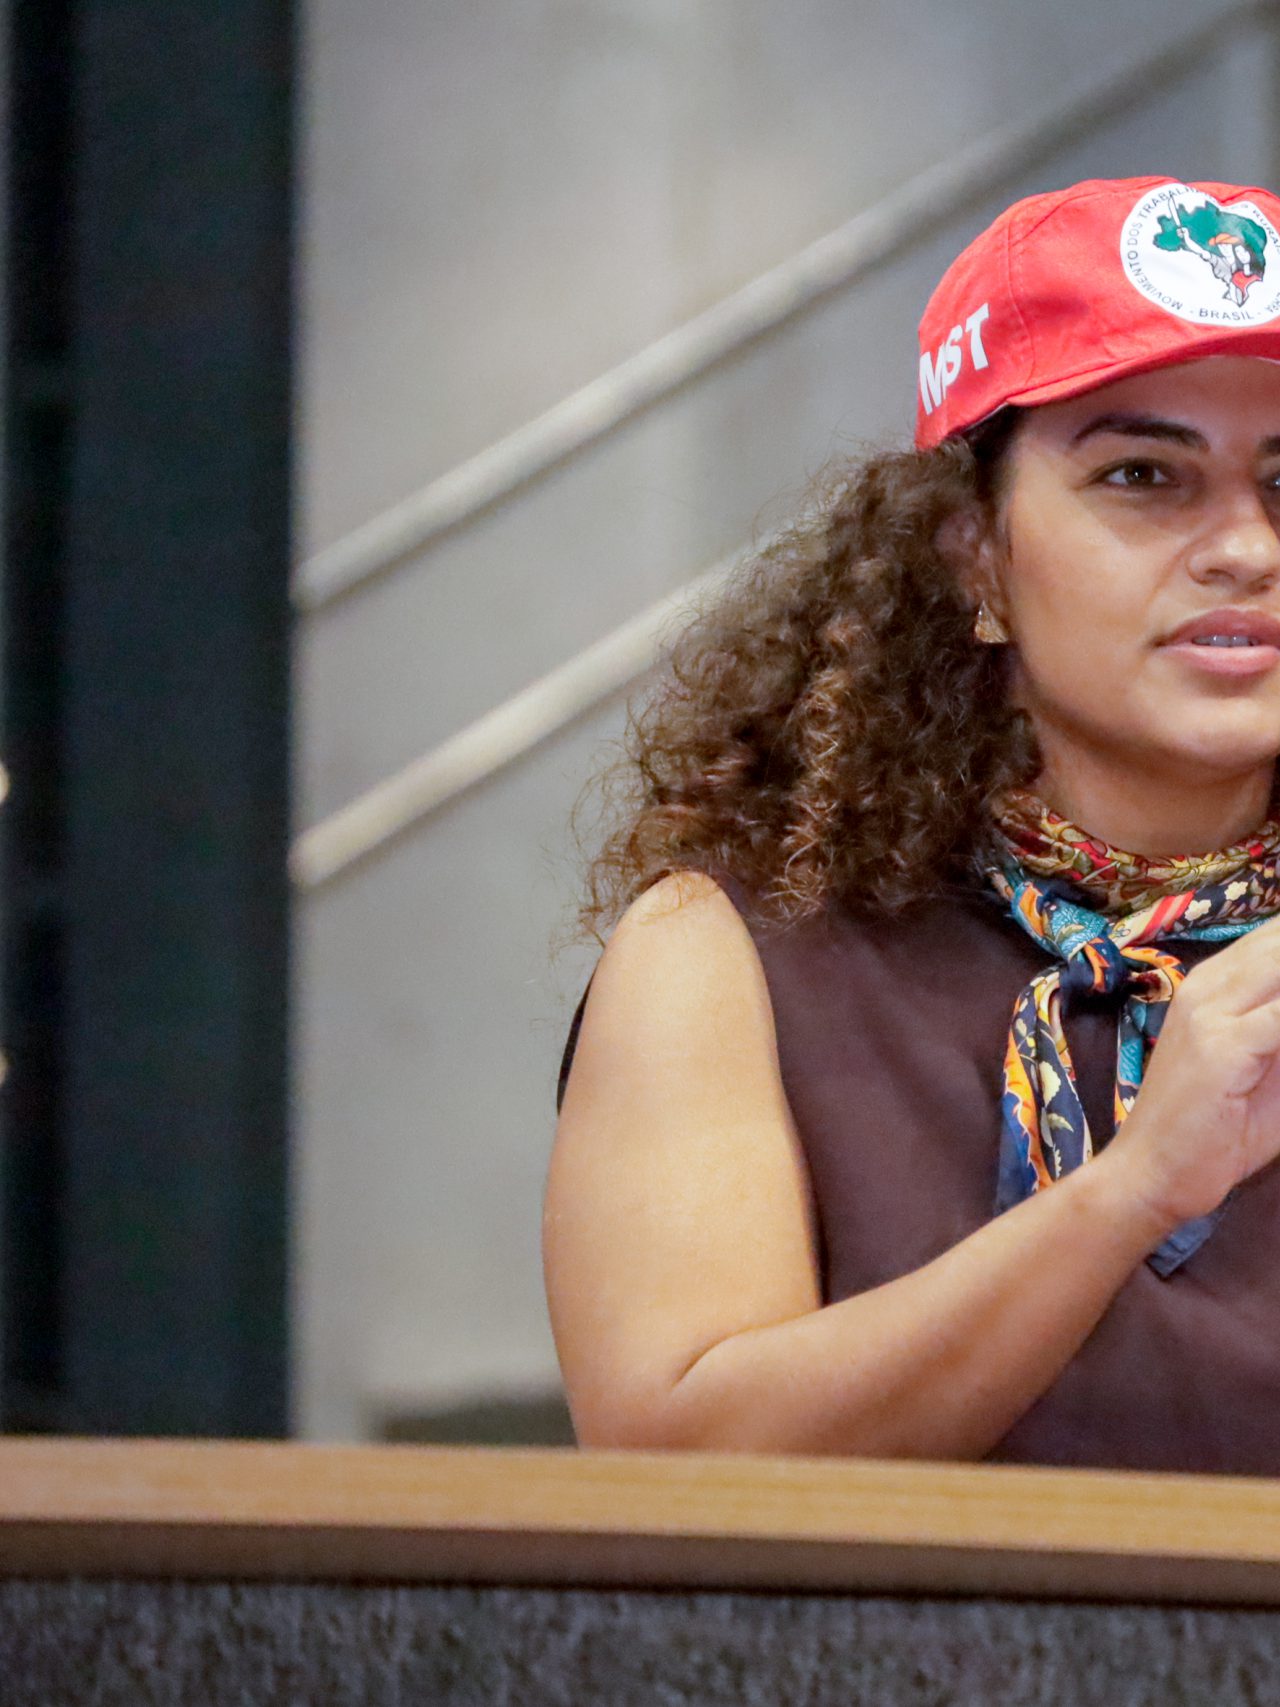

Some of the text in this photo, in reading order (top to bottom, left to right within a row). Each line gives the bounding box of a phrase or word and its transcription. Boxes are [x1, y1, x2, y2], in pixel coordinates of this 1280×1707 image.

[1127, 222, 1142, 246] DOS
[1127, 250, 1183, 310] MOVIMENTO
[1199, 308, 1254, 321] BRASIL
[919, 302, 989, 416] MST
